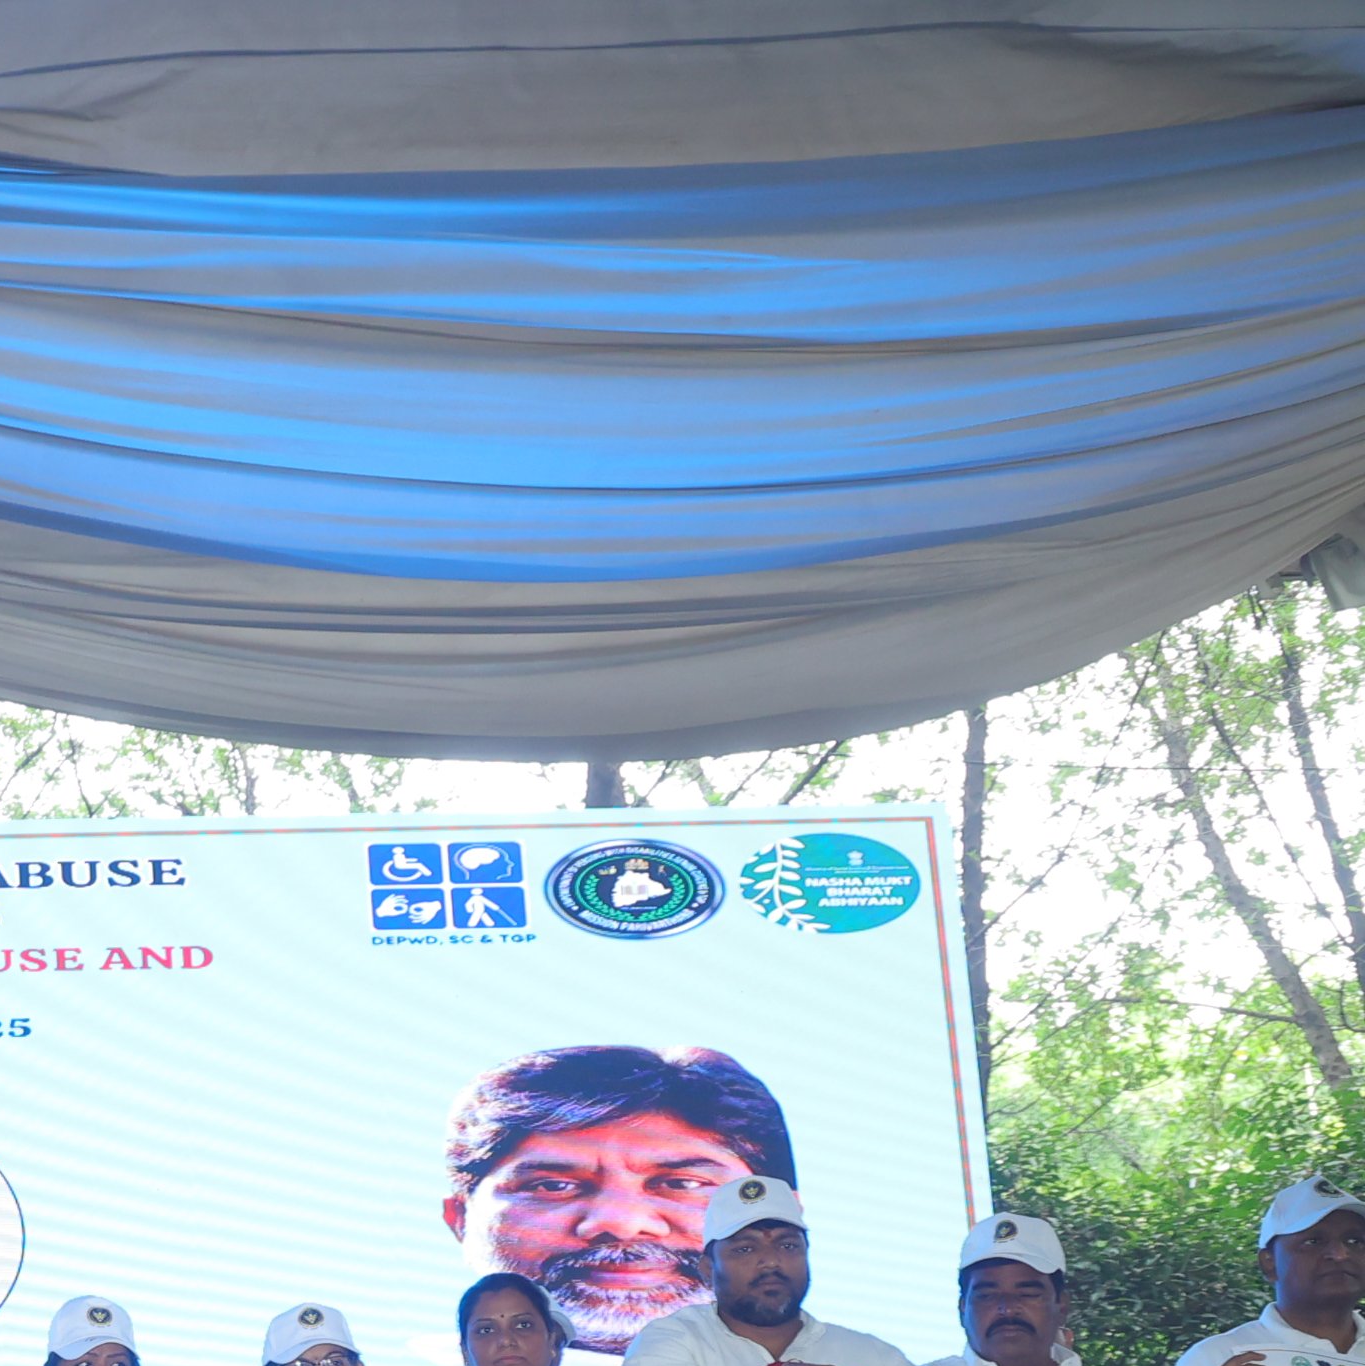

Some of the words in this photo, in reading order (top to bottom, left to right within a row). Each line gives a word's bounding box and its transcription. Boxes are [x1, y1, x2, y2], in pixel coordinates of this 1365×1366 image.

[805, 878, 862, 887] NASHA
[865, 876, 913, 885] MUKT
[827, 887, 892, 897] BHARAT
[819, 897, 904, 907] ABHIYAAN
[372, 936, 443, 945] DEPWD,
[449, 935, 473, 944] SC
[500, 934, 536, 943] TGP
[98, 945, 215, 971] AND
